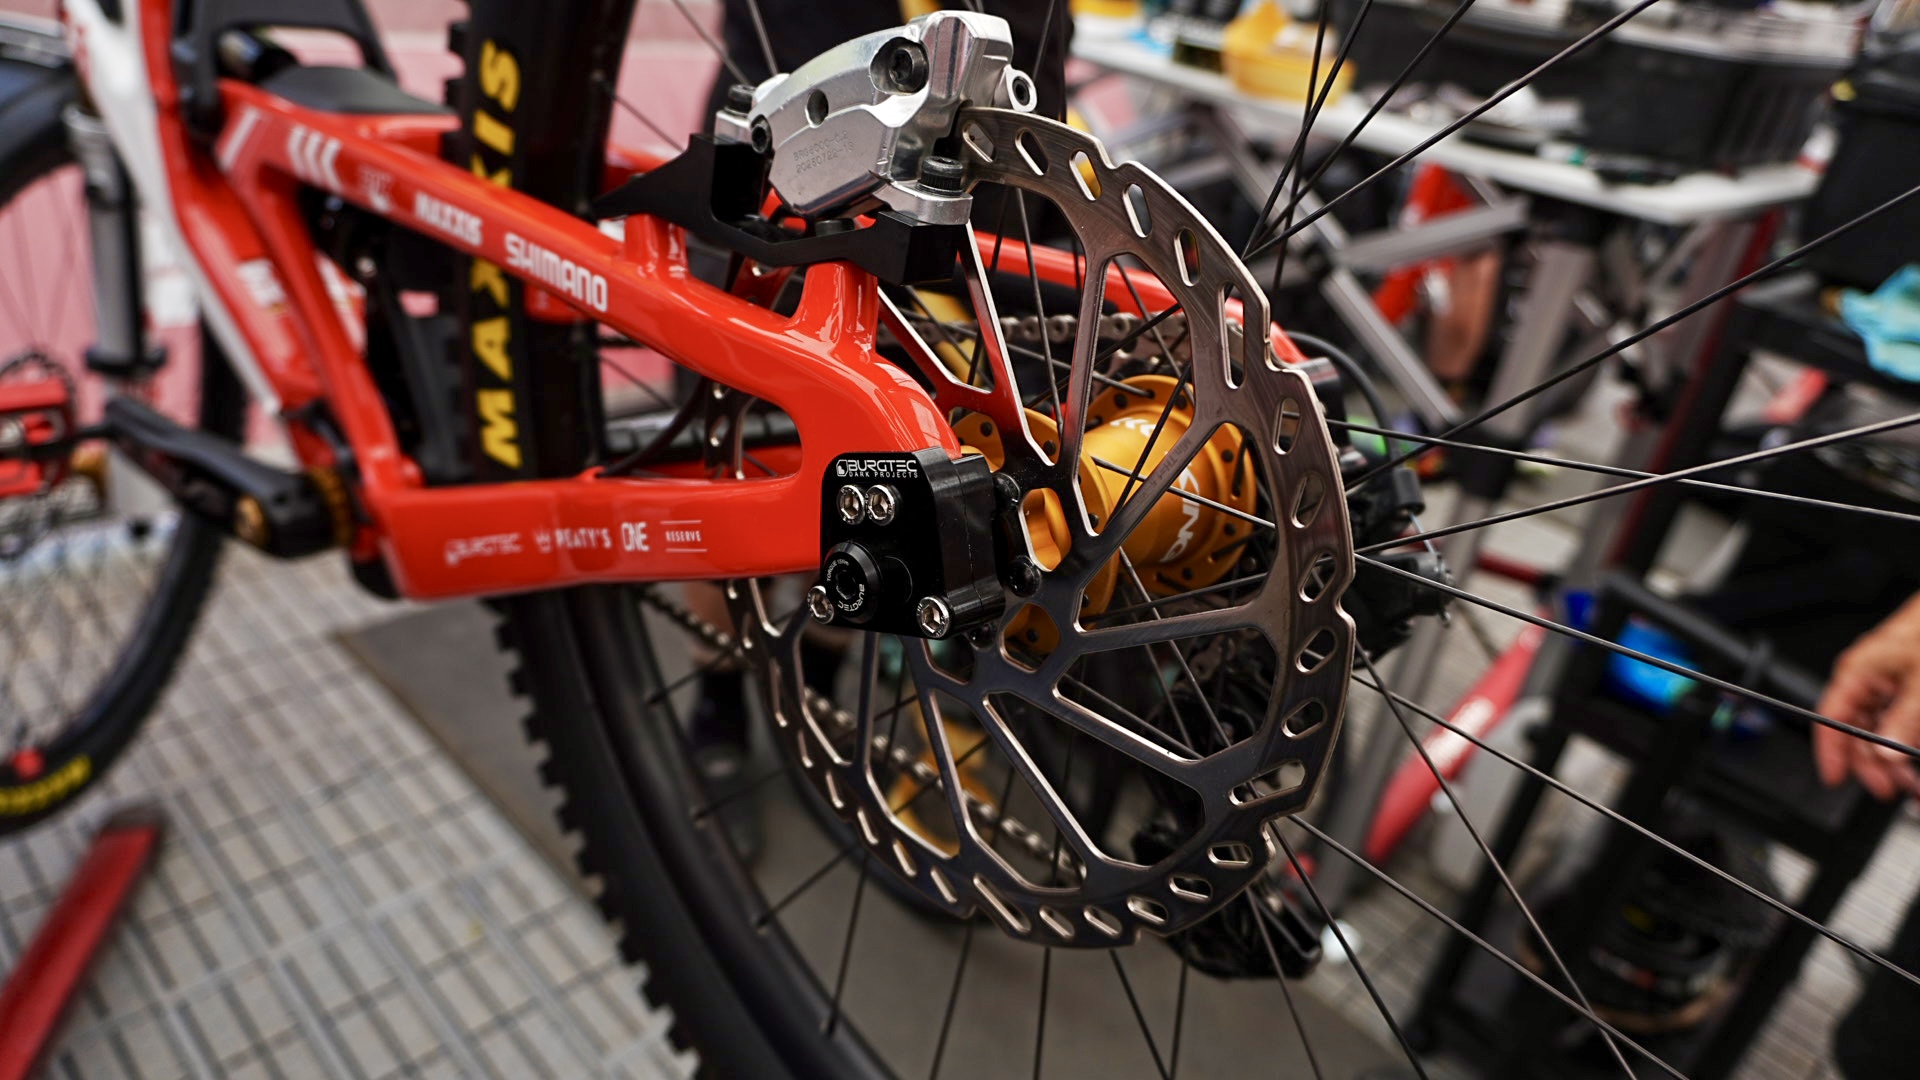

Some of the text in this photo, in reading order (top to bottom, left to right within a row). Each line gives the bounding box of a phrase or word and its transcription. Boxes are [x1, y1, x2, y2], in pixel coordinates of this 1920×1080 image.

[415, 191, 482, 247] MAXXIS
[504, 233, 609, 313] SHIMANO
[847, 459, 918, 472] BURGTEC
[555, 528, 611, 549] PEATY'S
[621, 521, 650, 552] ONE
[665, 531, 702, 542] RESERVE
[837, 583, 866, 612] BURGTEC
